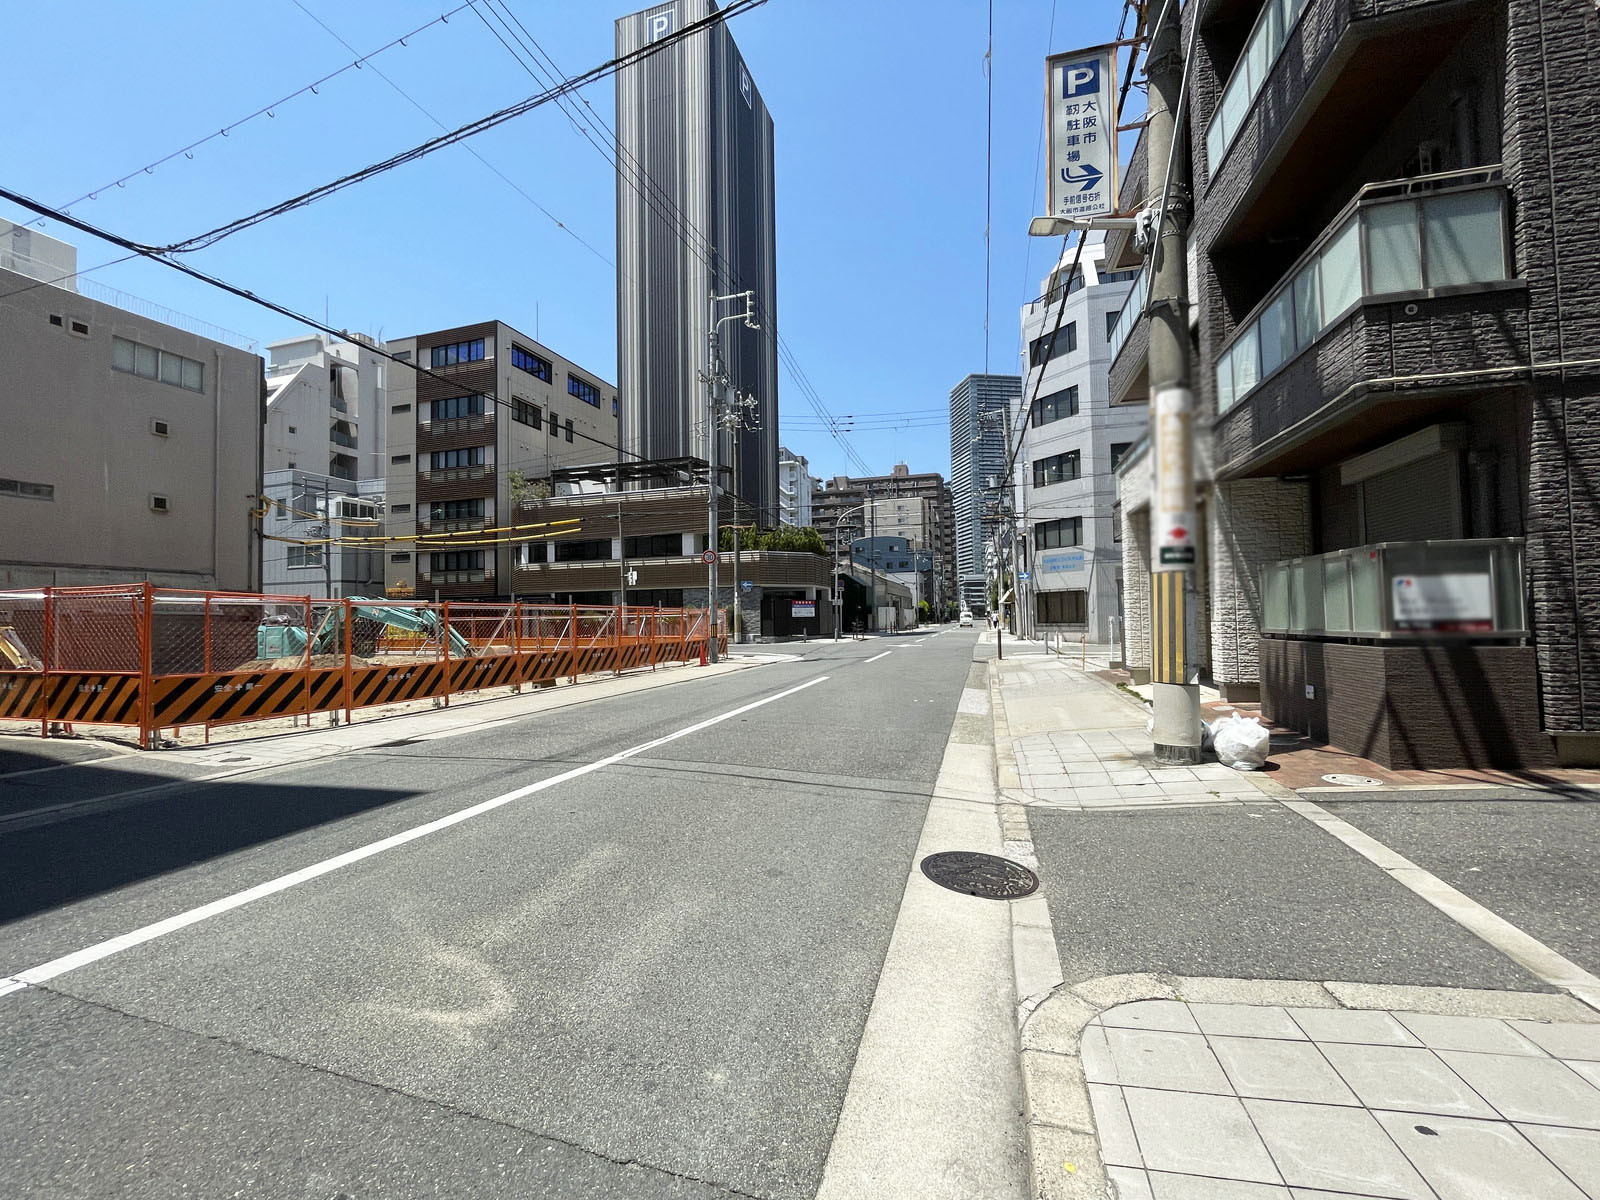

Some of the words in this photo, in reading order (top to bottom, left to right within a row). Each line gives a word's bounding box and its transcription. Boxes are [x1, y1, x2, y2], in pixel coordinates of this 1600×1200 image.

[653, 16, 668, 43] P
[1067, 68, 1094, 95] P
[1083, 101, 1097, 144] 大阪市
